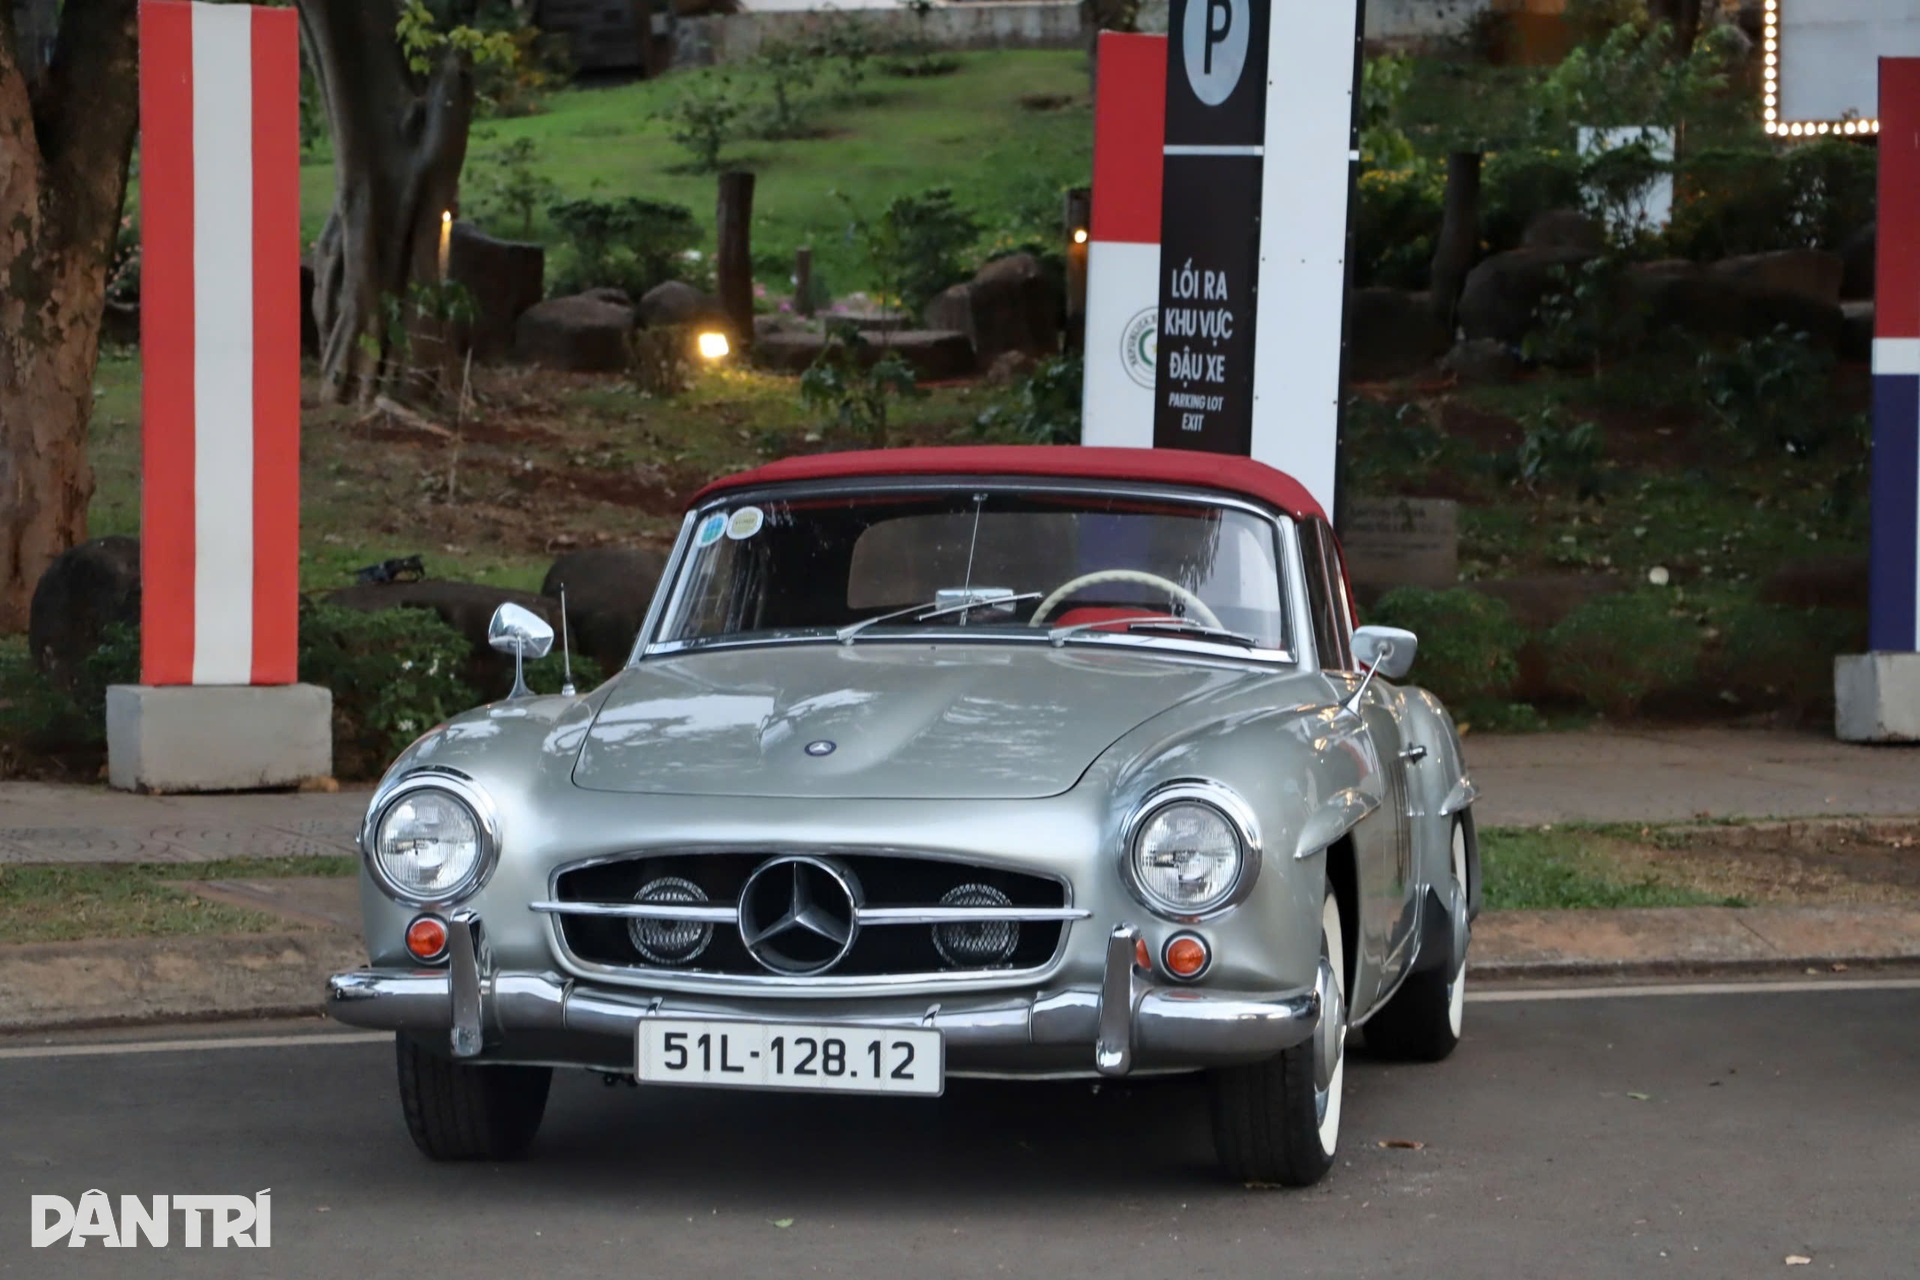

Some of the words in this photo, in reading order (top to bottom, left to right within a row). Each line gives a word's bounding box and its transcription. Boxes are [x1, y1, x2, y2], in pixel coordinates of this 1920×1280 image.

[1204, 0, 1232, 75] P
[1172, 257, 1199, 299] LỐI
[1204, 270, 1228, 300] RA
[1165, 308, 1197, 337] KHU
[1200, 308, 1233, 347] VỰC
[1169, 345, 1203, 388] ĐẬU
[1206, 354, 1225, 382] XE
[1168, 391, 1206, 410] PARKING
[1207, 396, 1224, 412] LOT
[1182, 413, 1204, 432] EXIT
[664, 1032, 915, 1080] 51L-128.12
